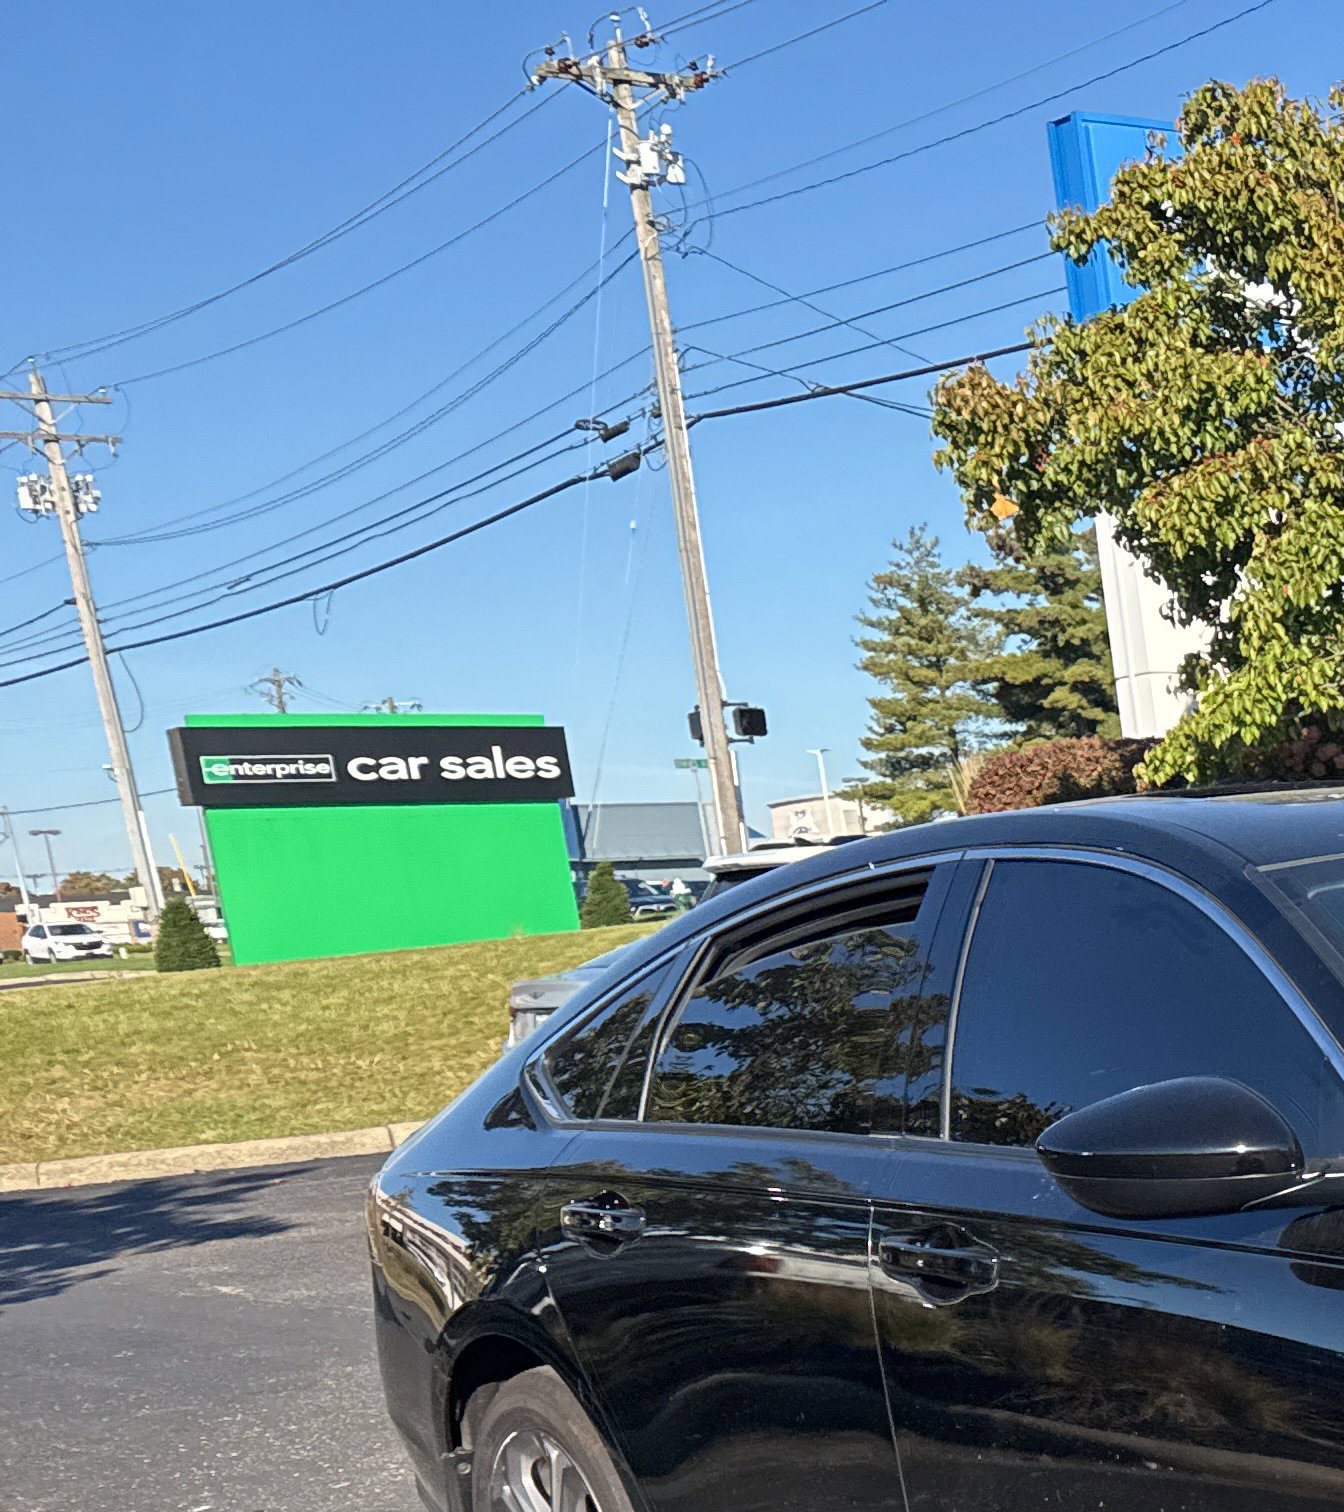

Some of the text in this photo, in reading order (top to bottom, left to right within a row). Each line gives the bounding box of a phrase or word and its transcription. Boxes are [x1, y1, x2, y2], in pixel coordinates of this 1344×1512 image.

[205, 745, 562, 781] enterprise car sales
